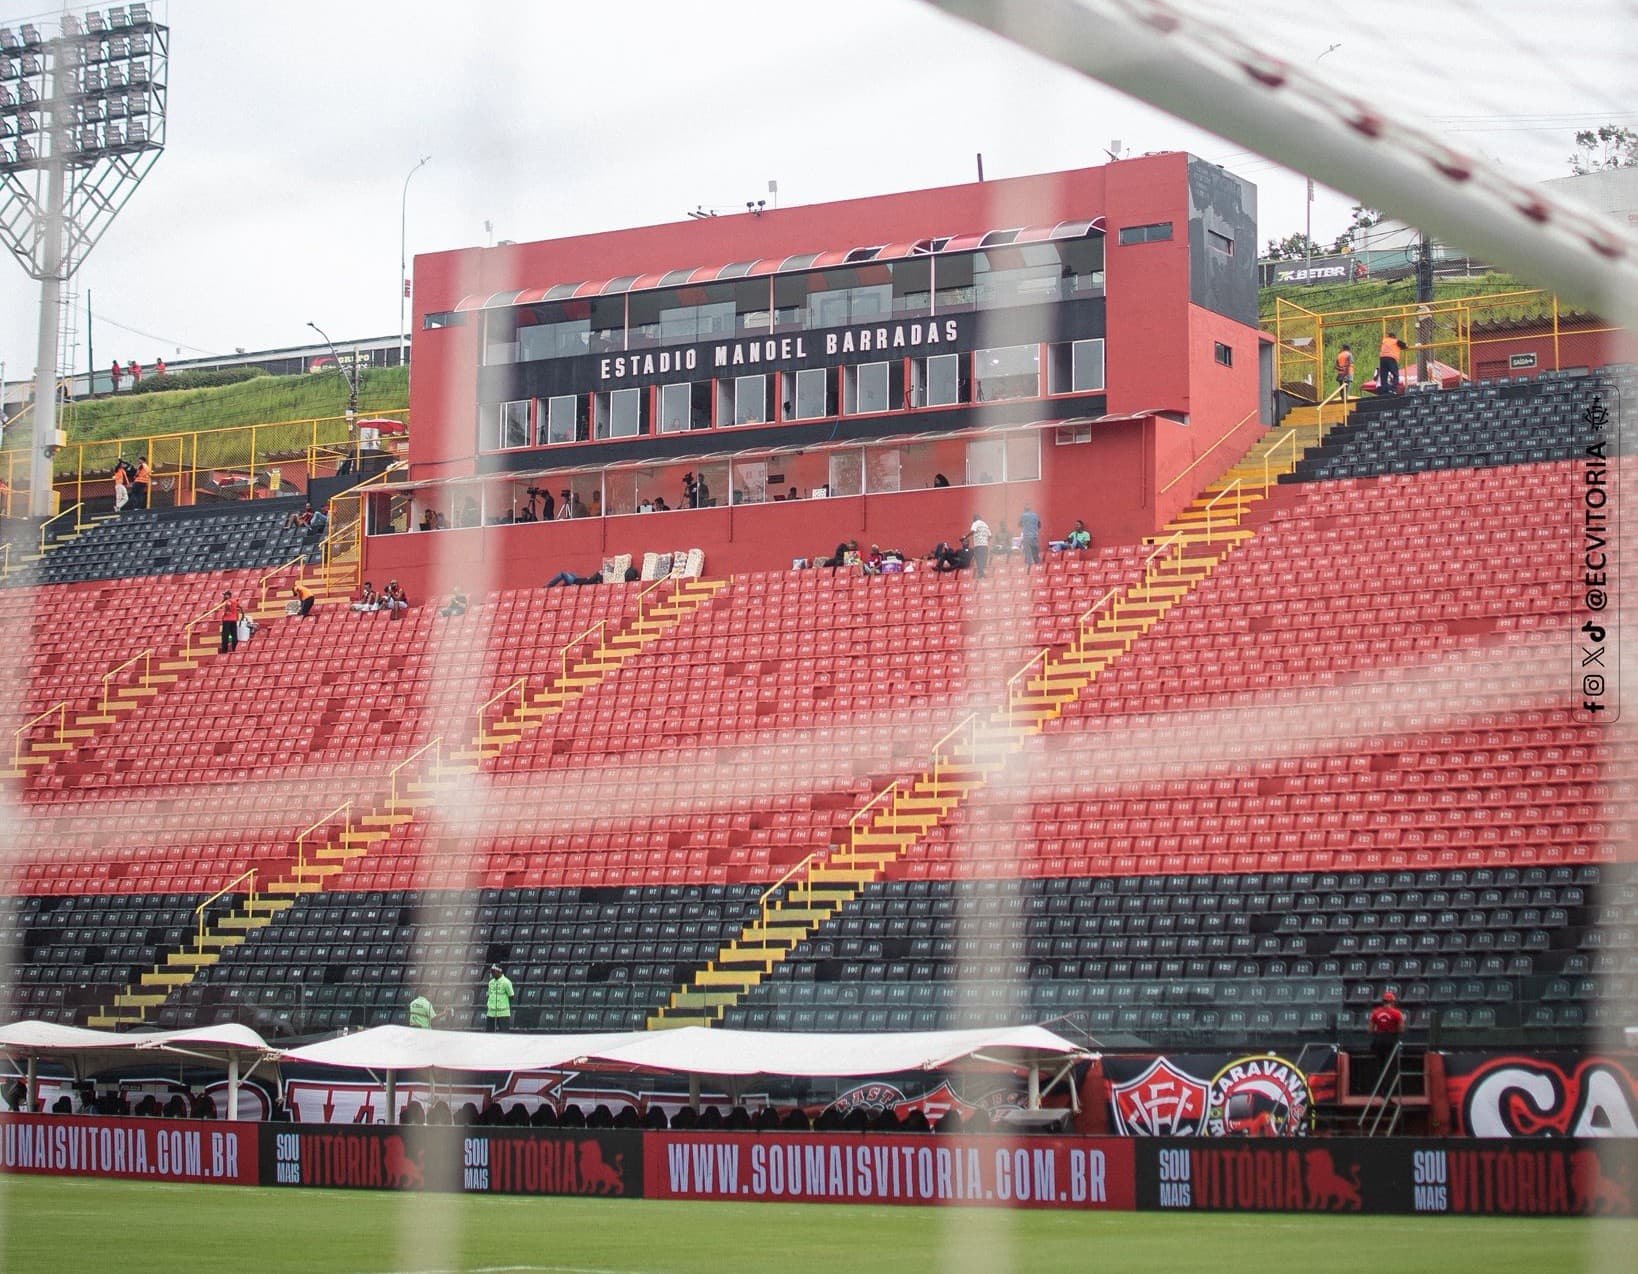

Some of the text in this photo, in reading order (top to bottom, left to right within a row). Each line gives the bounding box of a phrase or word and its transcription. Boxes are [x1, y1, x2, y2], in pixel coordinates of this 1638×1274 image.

[601, 320, 958, 379] ESTADIO MANOEL BARRADAS
[0, 1124, 239, 1178] UMAISVITORIA.COM.BR
[277, 1134, 299, 1161] SOU
[300, 1131, 382, 1188] VITÓRIA
[465, 1138, 488, 1166] SOU
[490, 1135, 577, 1192] VITÓRIA
[277, 1163, 299, 1184] MAIS
[465, 1168, 488, 1190] MAIS
[667, 1143, 1107, 1202] WWW.SOUMAISVITORIA.COM.BR
[1160, 1149, 1190, 1181] SOU
[1414, 1151, 1446, 1183] SOU
[1160, 1183, 1190, 1207] MAIS
[1415, 1186, 1447, 1211] MAIS
